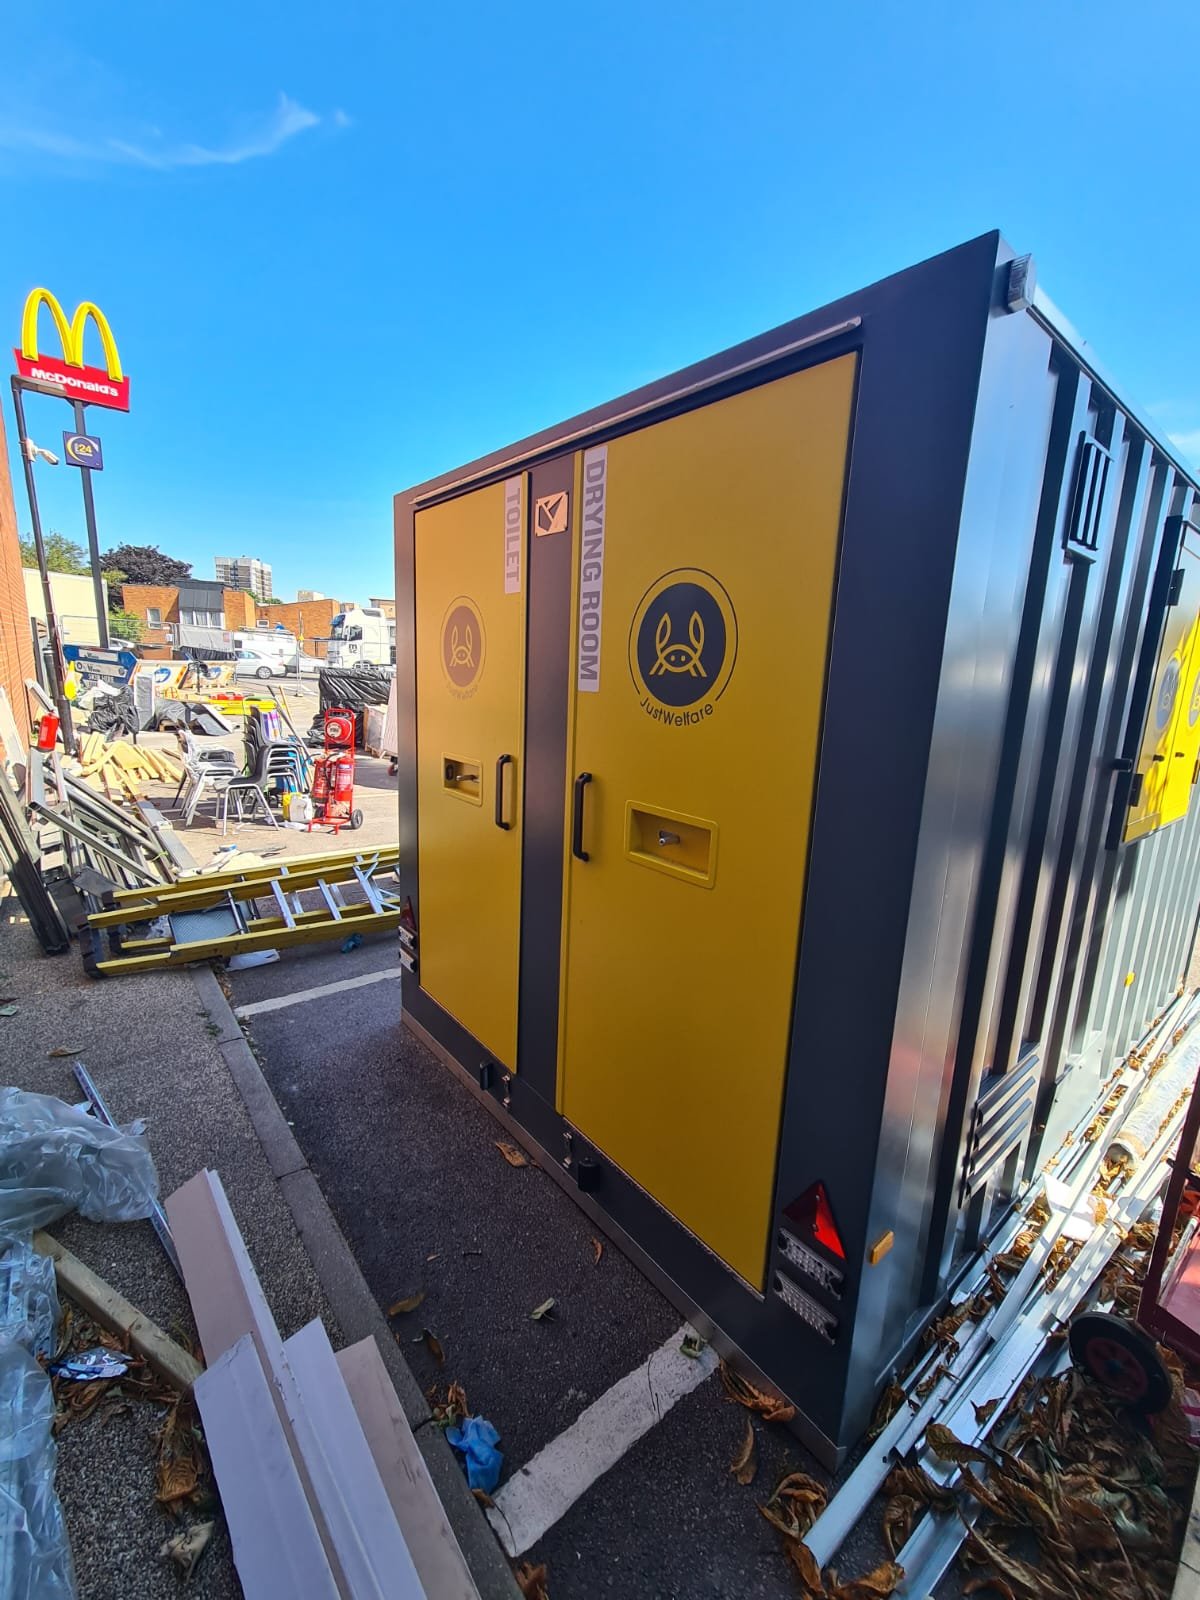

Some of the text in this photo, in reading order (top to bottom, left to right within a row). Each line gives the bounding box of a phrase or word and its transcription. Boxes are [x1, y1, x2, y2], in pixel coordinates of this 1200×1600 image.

[31, 367, 119, 397] McDonald's
[505, 487, 521, 582] TOILET
[580, 459, 606, 680] DRYING ROOM
[640, 697, 714, 727] JustWelfare
